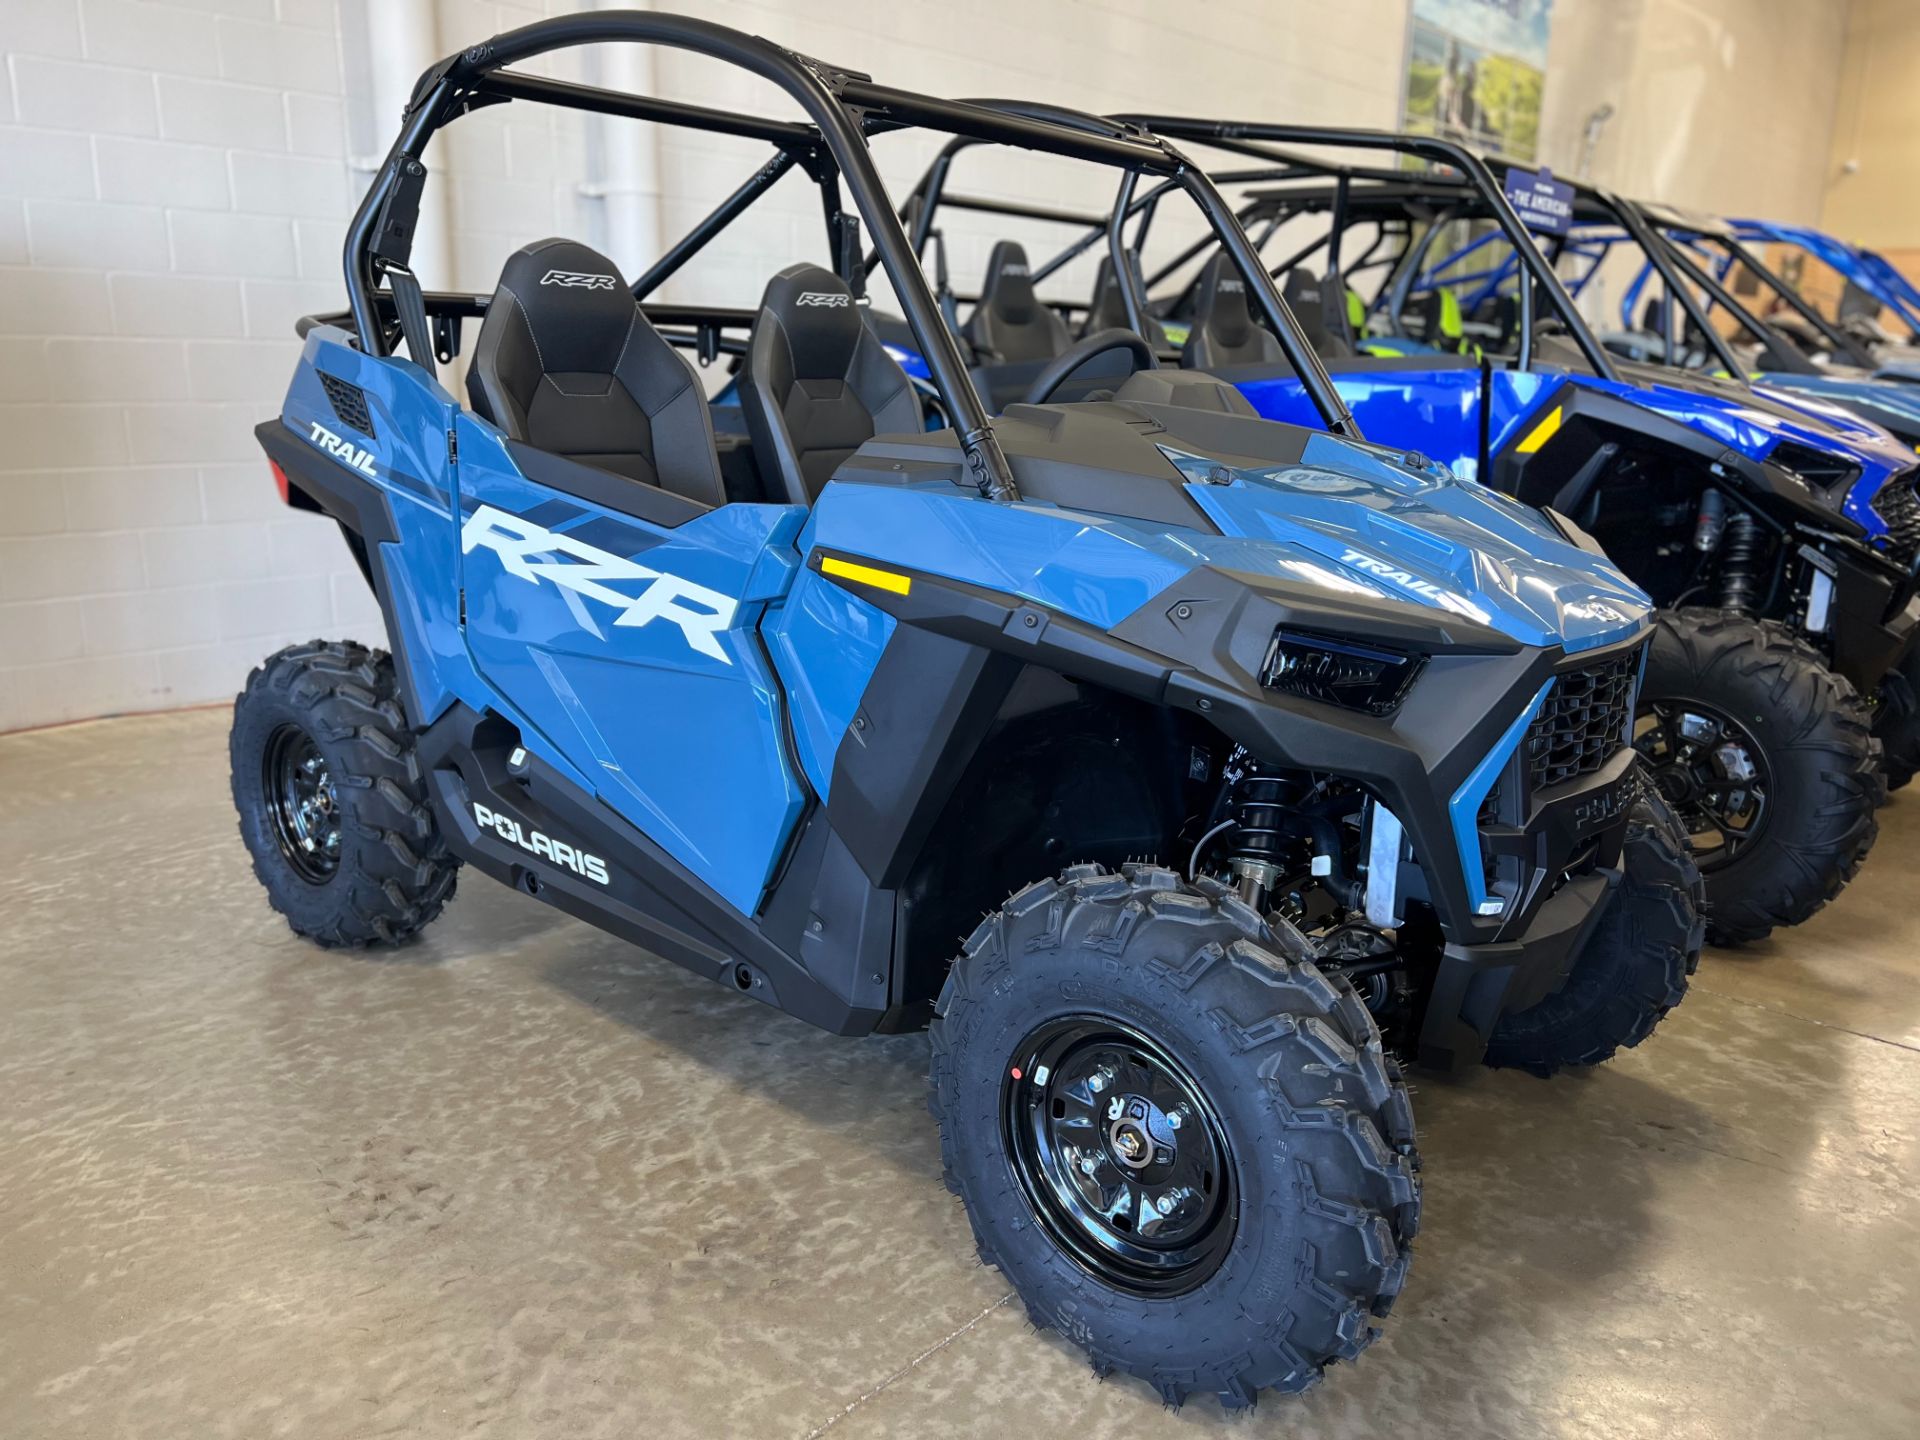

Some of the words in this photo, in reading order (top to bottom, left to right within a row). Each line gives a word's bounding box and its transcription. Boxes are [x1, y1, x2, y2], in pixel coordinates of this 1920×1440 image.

[540, 270, 616, 289] RZR
[796, 291, 849, 308] RZR
[310, 421, 377, 477] TRAIL
[461, 504, 738, 665] RZR
[1340, 549, 1442, 600] TRAIL
[473, 802, 609, 885] POLARIS
